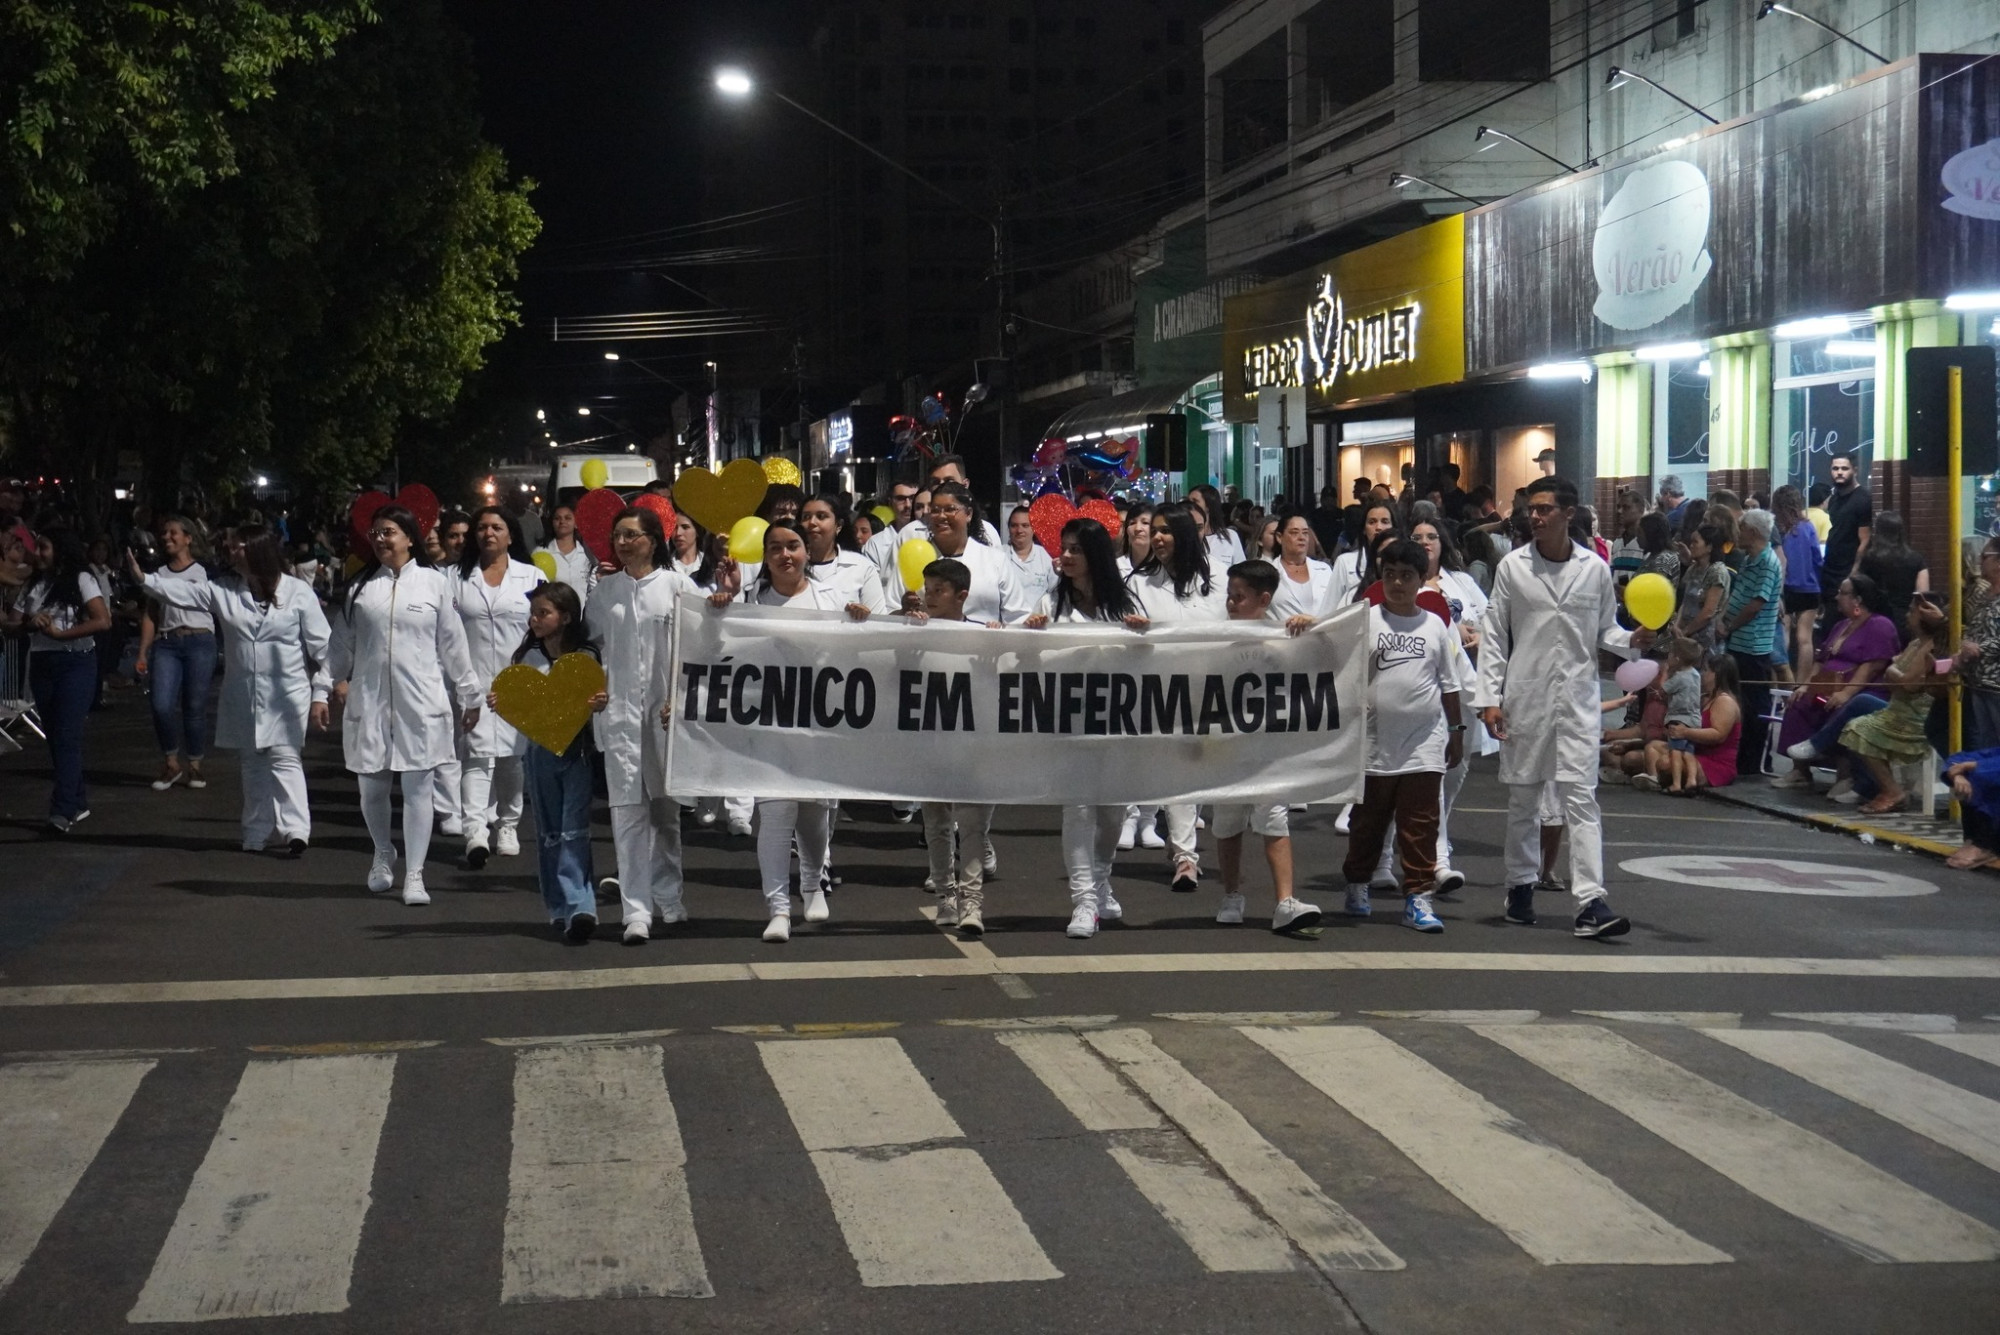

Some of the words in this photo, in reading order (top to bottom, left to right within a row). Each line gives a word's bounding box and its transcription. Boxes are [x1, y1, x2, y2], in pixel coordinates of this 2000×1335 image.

[1607, 243, 1684, 296] Verão
[1153, 303, 1162, 343] A
[1343, 301, 1420, 375] OUTLET
[1377, 632, 1426, 657] NIKE
[682, 656, 876, 729] TÉCNICO
[898, 669, 974, 732] EM
[998, 671, 1340, 735] ENFERMAGEM
